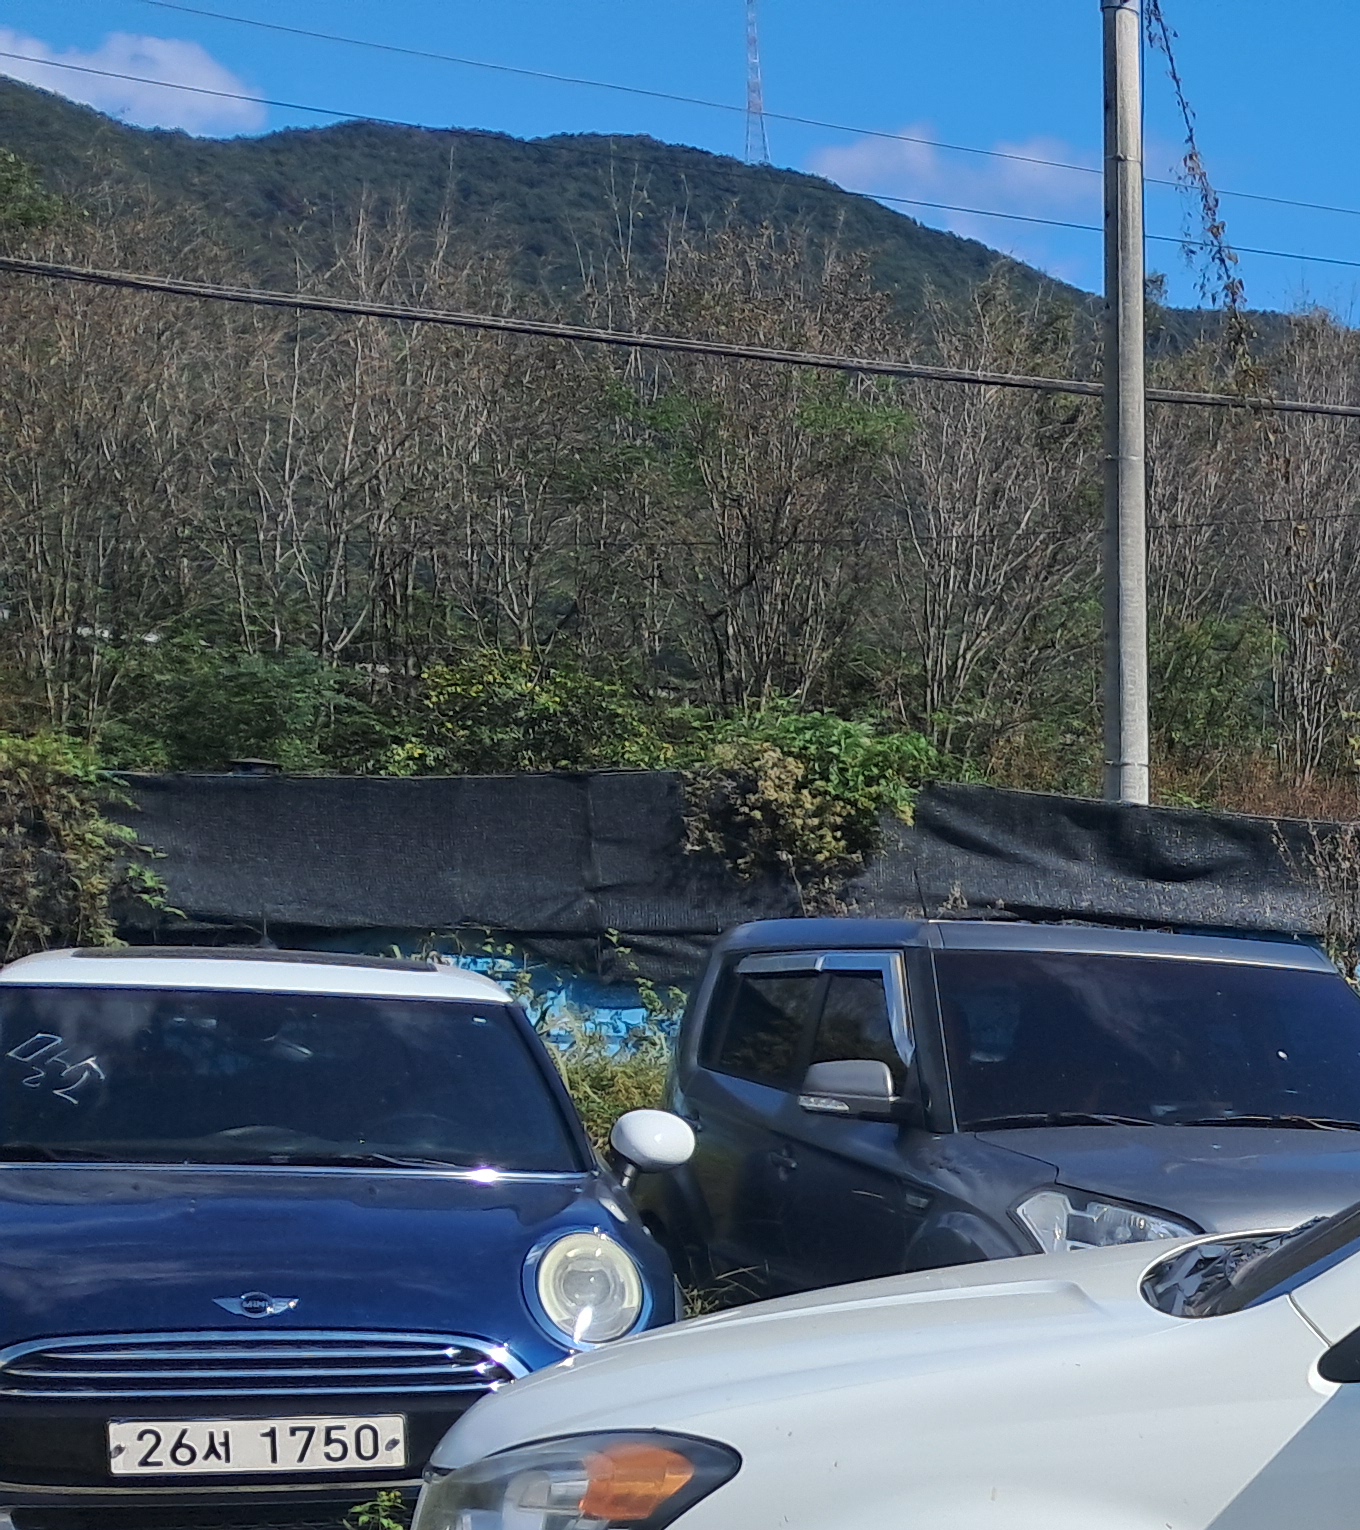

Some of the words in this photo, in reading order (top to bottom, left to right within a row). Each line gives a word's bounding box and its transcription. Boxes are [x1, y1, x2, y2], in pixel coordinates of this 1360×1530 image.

[242, 1300, 268, 1309] MINI
[136, 1427, 231, 1467] 26서
[260, 1423, 379, 1464] 1750
